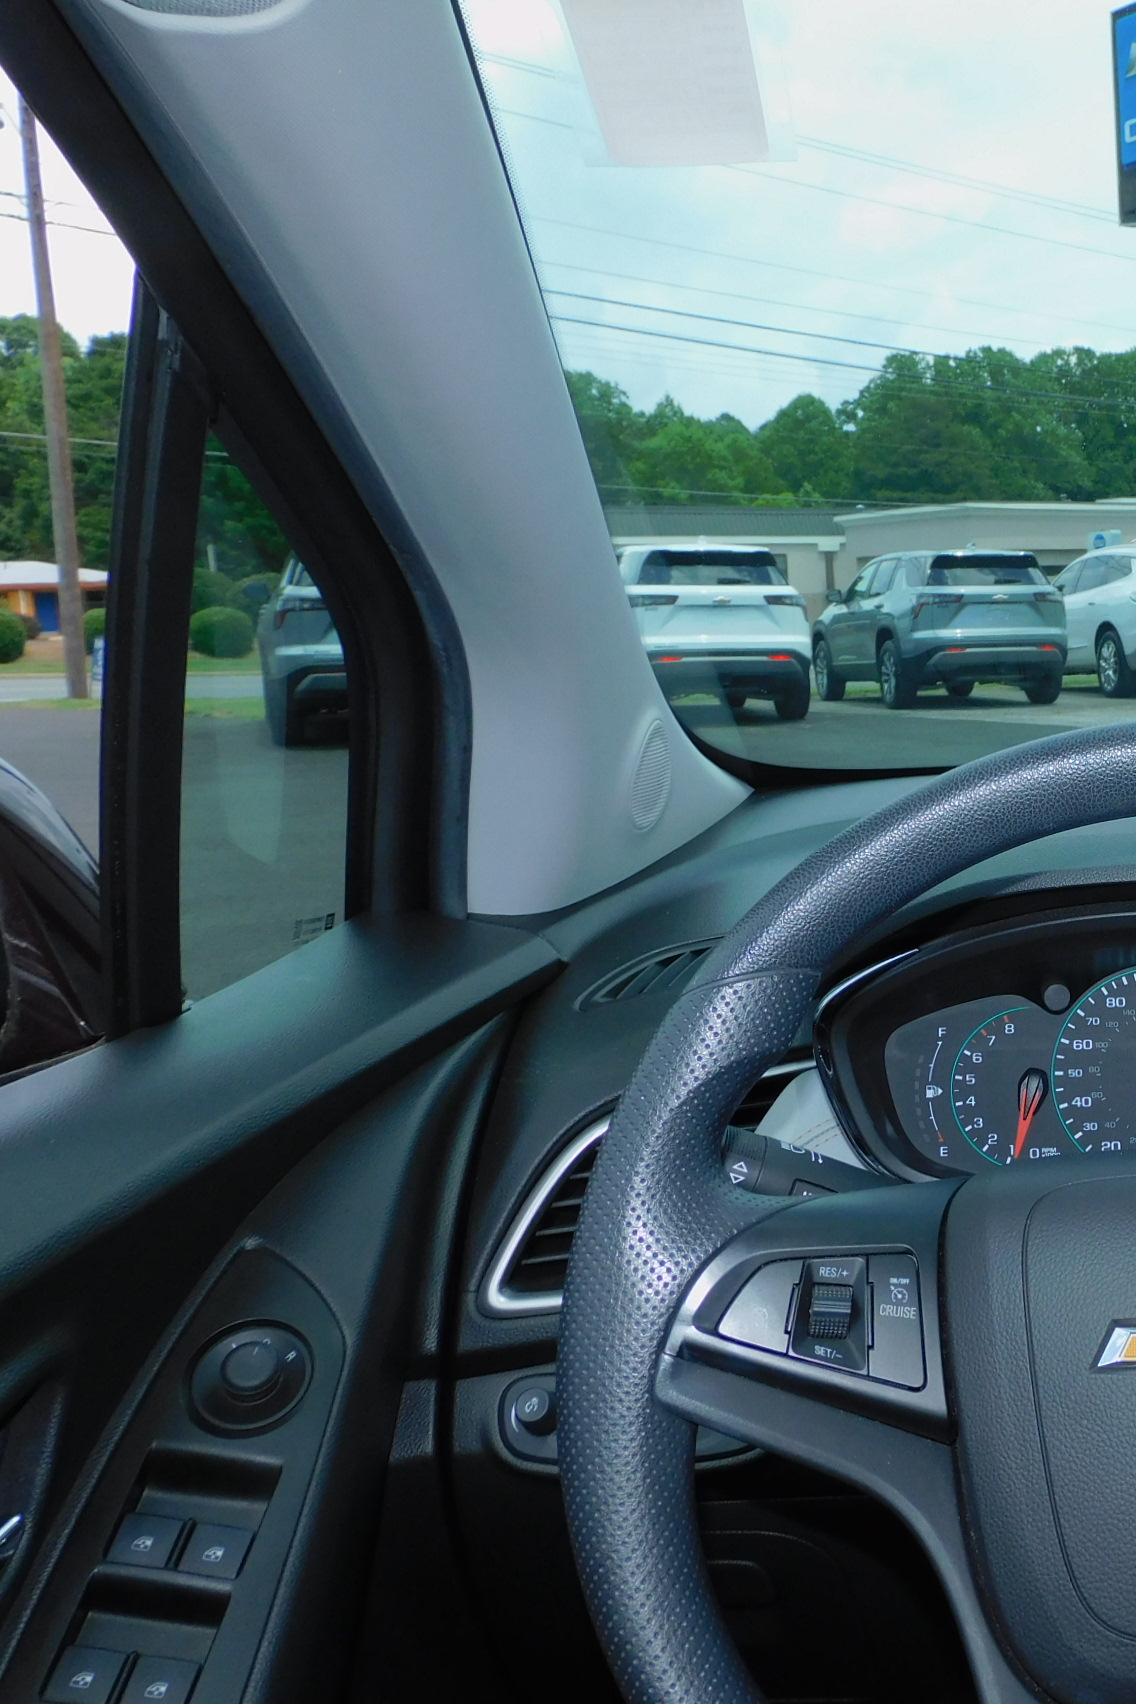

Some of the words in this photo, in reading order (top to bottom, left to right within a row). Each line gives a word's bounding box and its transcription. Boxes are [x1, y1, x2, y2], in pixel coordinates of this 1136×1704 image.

[1106, 997, 1126, 1008] 80
[1086, 1017, 1100, 1026] 70
[938, 1027, 947, 1037] F
[1004, 1023, 1015, 1034] 8
[987, 1035, 996, 1046] 7
[1072, 1039, 1093, 1050] 60
[972, 1053, 982, 1063] 6
[1068, 1069, 1083, 1078] 50
[966, 1074, 975, 1085] 5
[966, 1096, 976, 1107] 4
[1071, 1097, 1092, 1107] 40
[974, 1118, 983, 1128] 3
[1083, 1123, 1098, 1131] 30
[988, 1134, 998, 1145] 2
[940, 1146, 949, 1157] E
[1009, 1144, 1014, 1156] 1
[1101, 1142, 1121, 1151] 20
[1029, 1148, 1040, 1159] 0
[819, 1266, 850, 1278] RES/+
[880, 1303, 917, 1319] CRUISE
